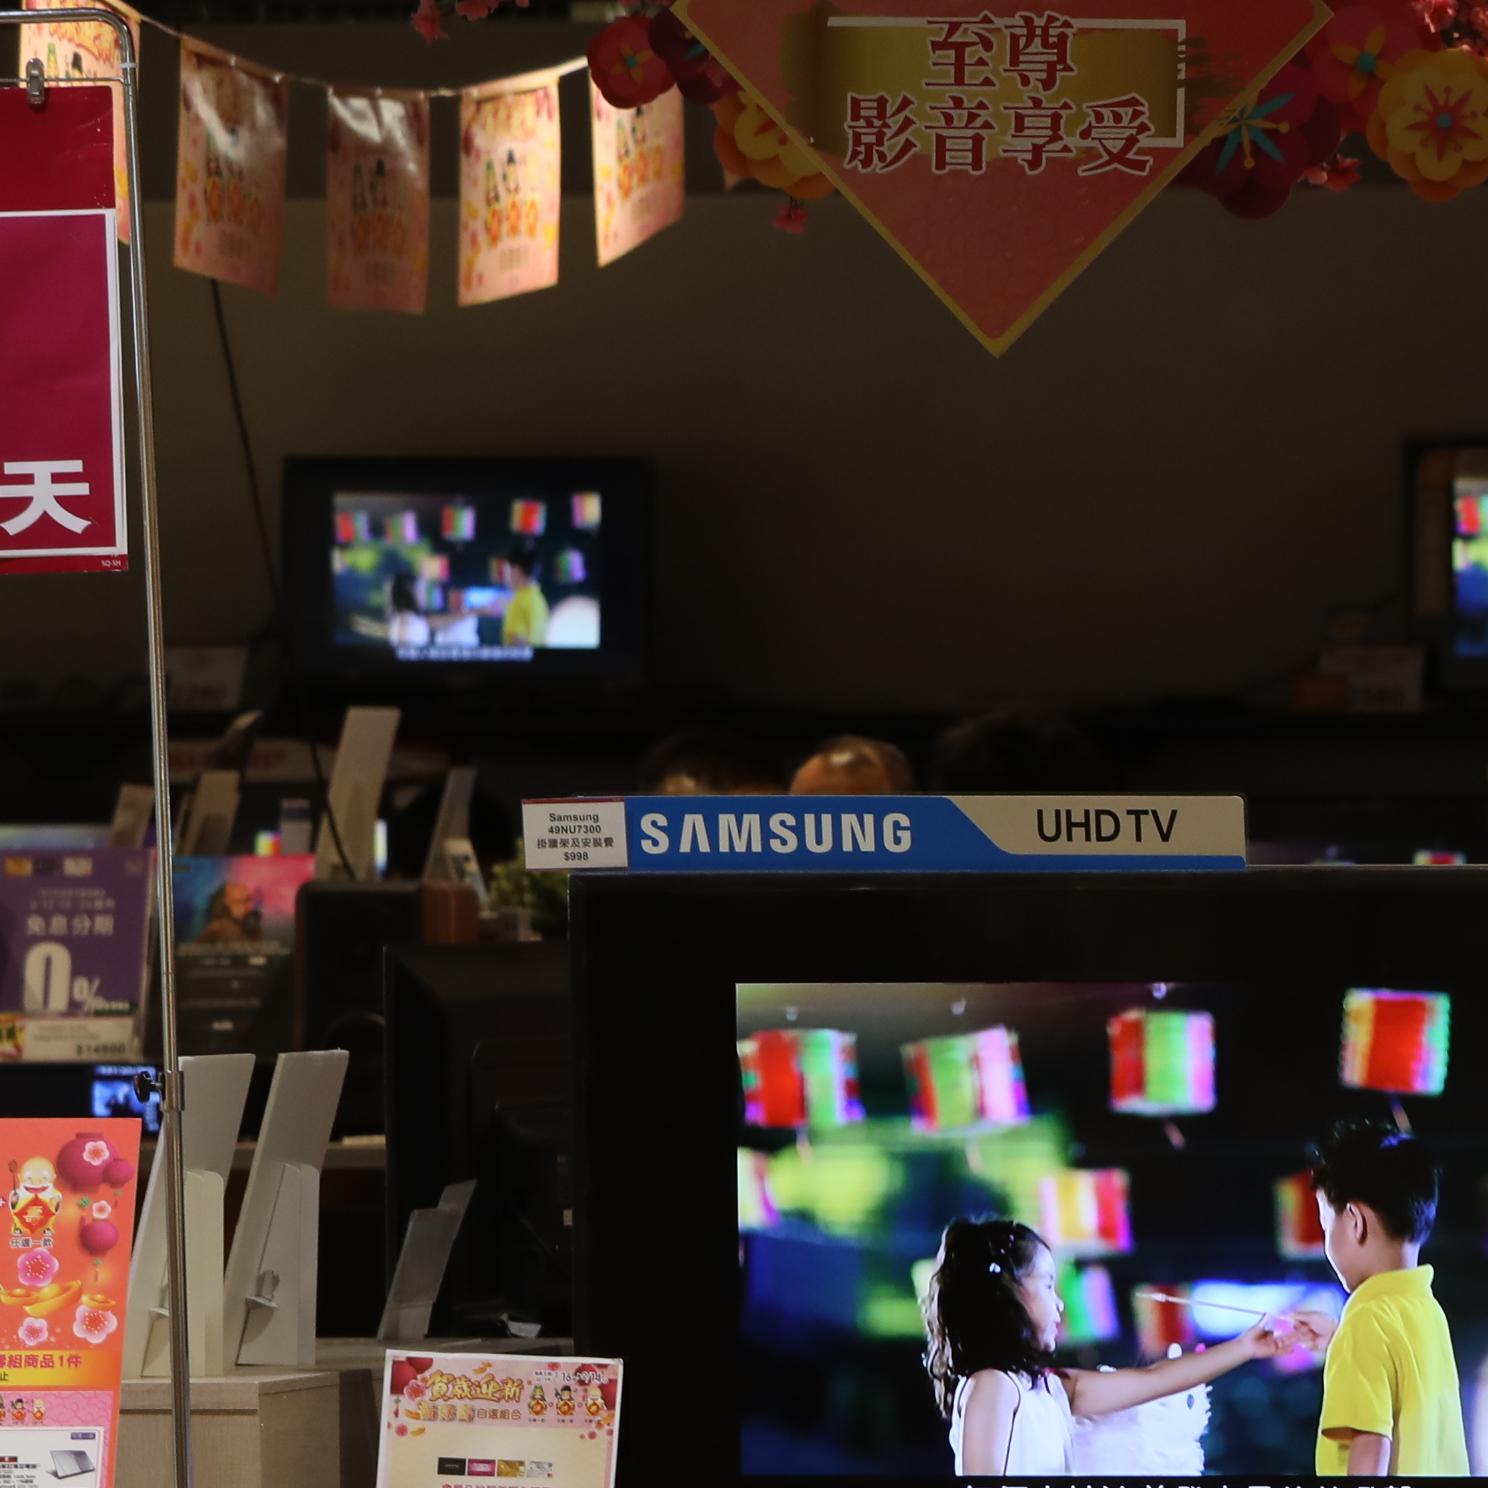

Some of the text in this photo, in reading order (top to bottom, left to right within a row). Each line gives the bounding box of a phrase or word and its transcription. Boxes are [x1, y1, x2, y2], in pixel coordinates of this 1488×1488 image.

[922, 10, 1077, 91] 至尊
[844, 92, 1153, 176] 影音享受
[0, 460, 92, 536] 天
[548, 824, 601, 834] 49NU7300
[549, 813, 599, 825] Samsung
[640, 811, 912, 854] SAMSUNG
[564, 851, 588, 861] $998
[426, 1369, 523, 1403] 賀歲迎新
[477, 1408, 522, 1421] 自選組合
